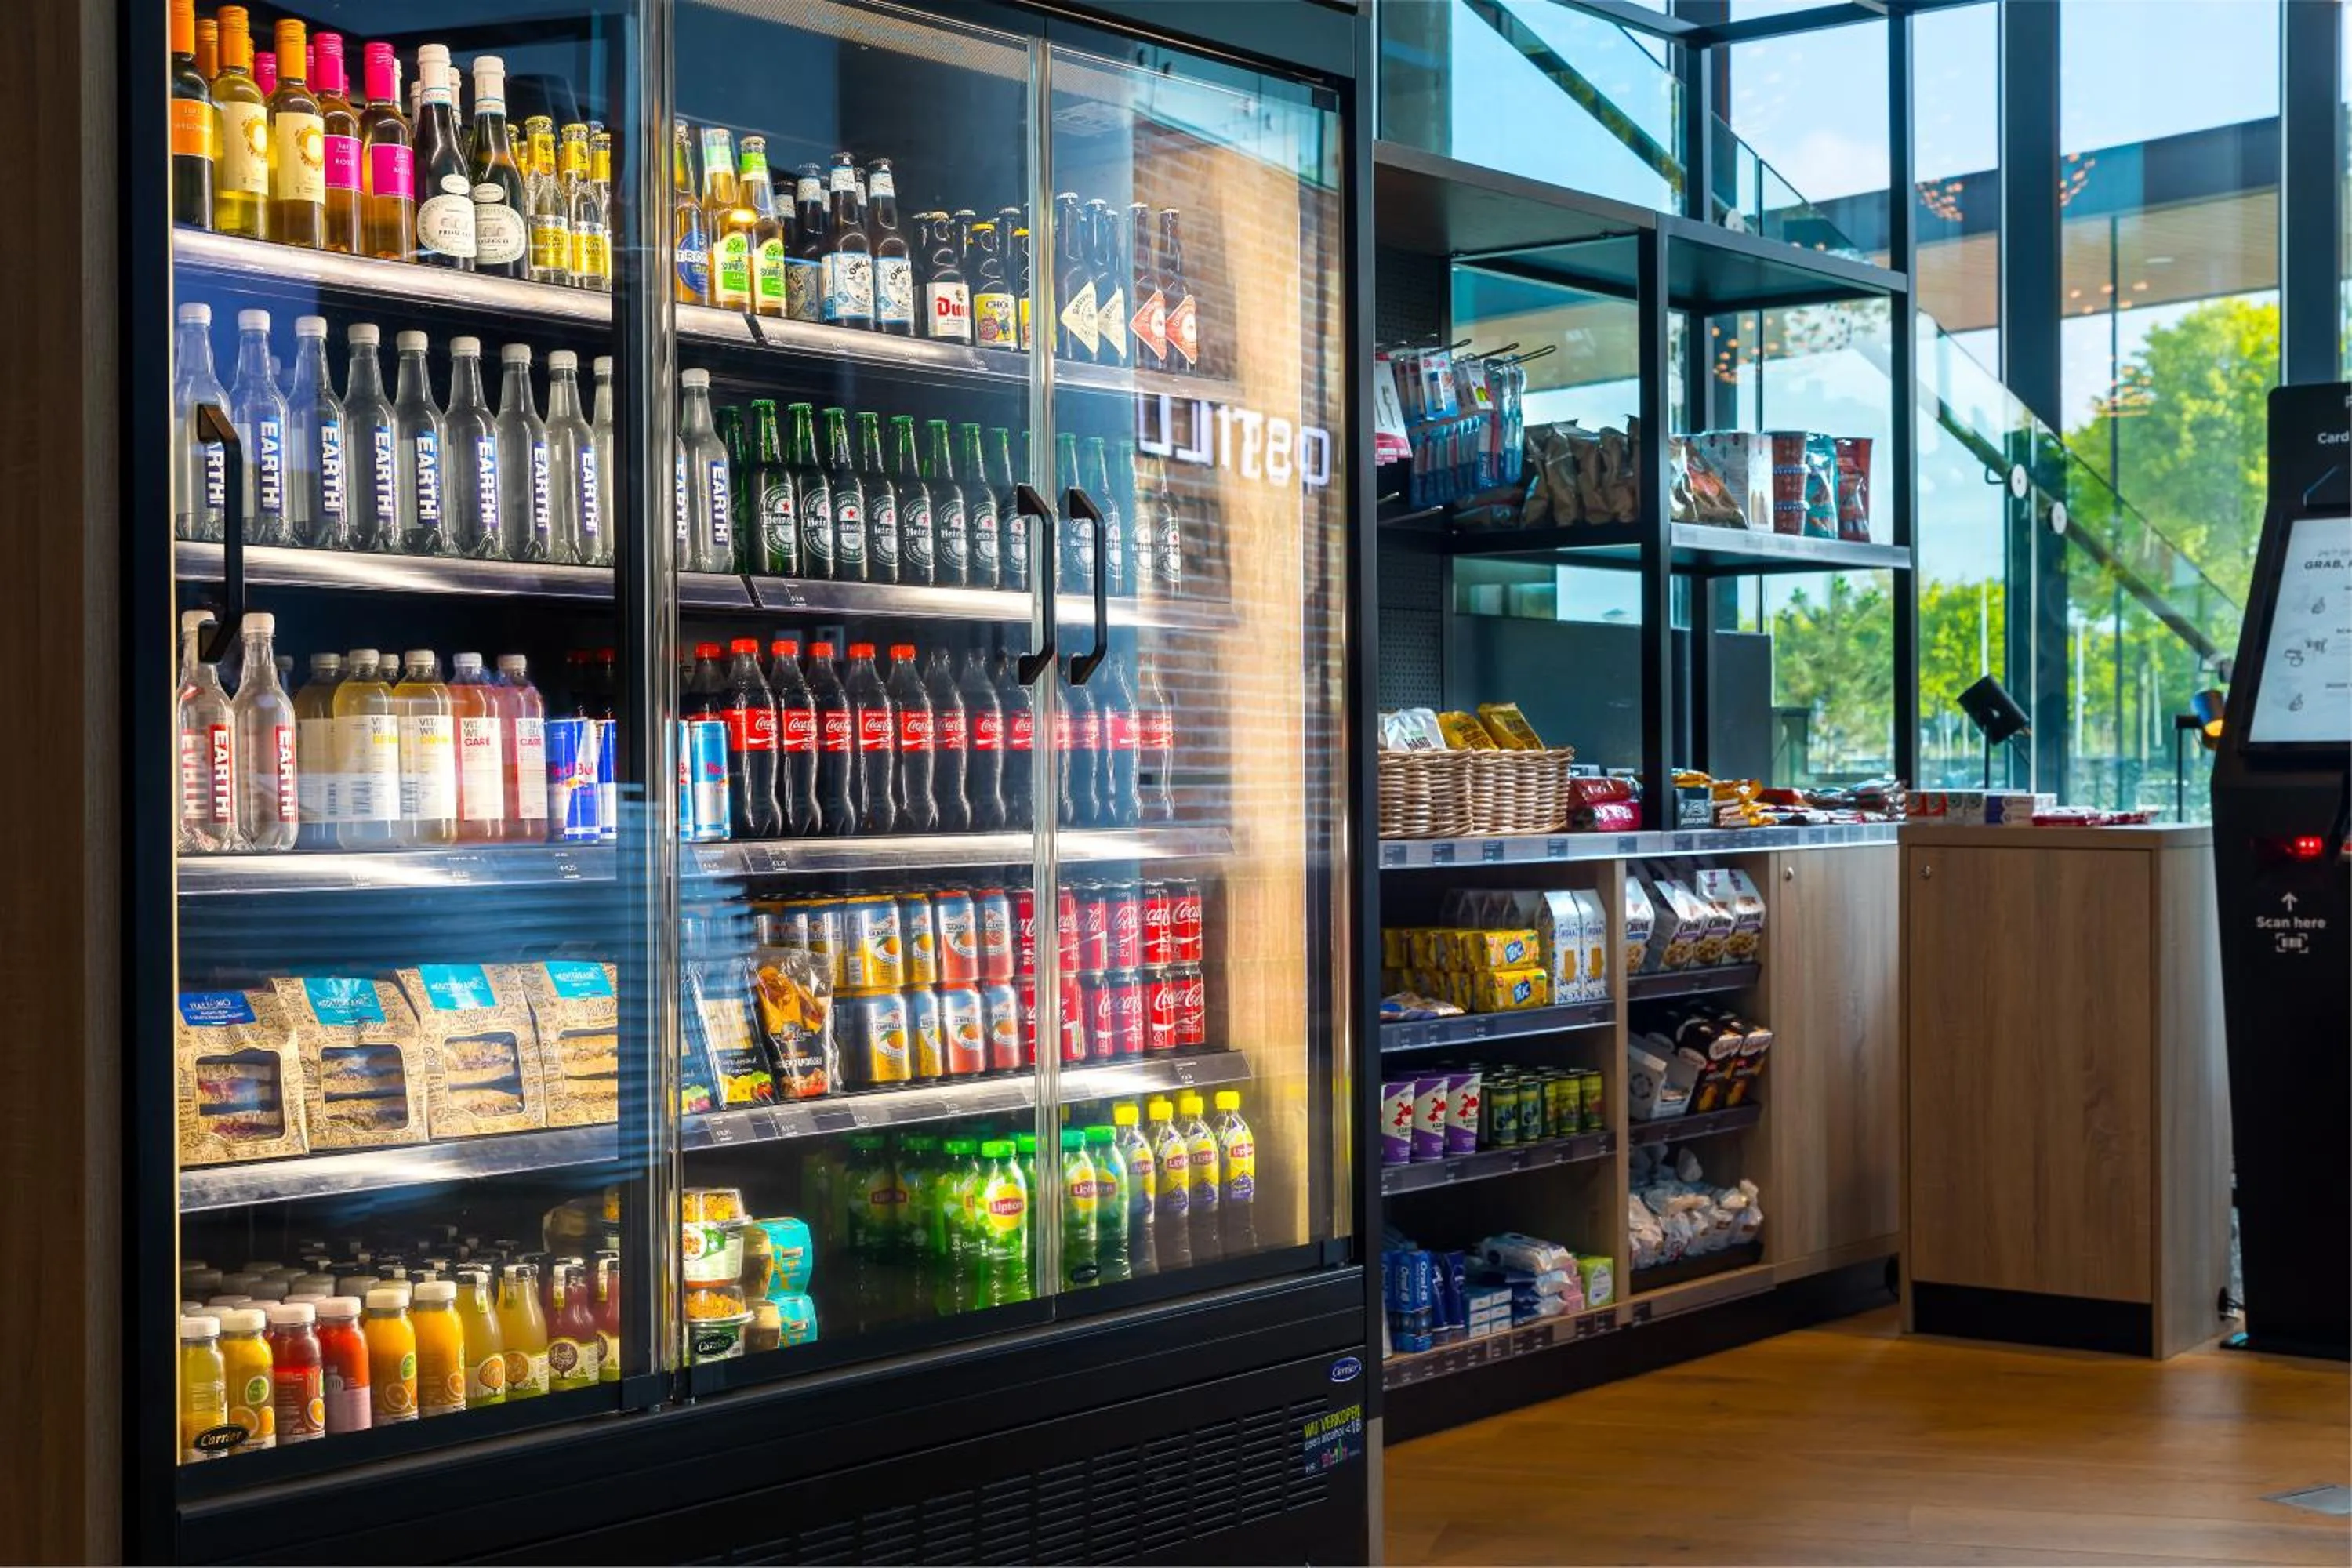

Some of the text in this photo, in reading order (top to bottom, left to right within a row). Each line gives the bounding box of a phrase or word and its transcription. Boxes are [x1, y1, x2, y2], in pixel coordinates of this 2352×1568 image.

[260, 422, 281, 509] EARTH
[321, 426, 341, 512] EARTH
[376, 432, 394, 517] EARTH
[416, 437, 437, 521] EARTH
[2317, 430, 2349, 445] Card
[478, 441, 498, 523] EARTH
[712, 466, 729, 543] EARTH
[214, 730, 231, 818] EARTH
[278, 729, 296, 817] EARTH
[2256, 916, 2327, 929] Scan here
[993, 1200, 1023, 1214] Lipton
